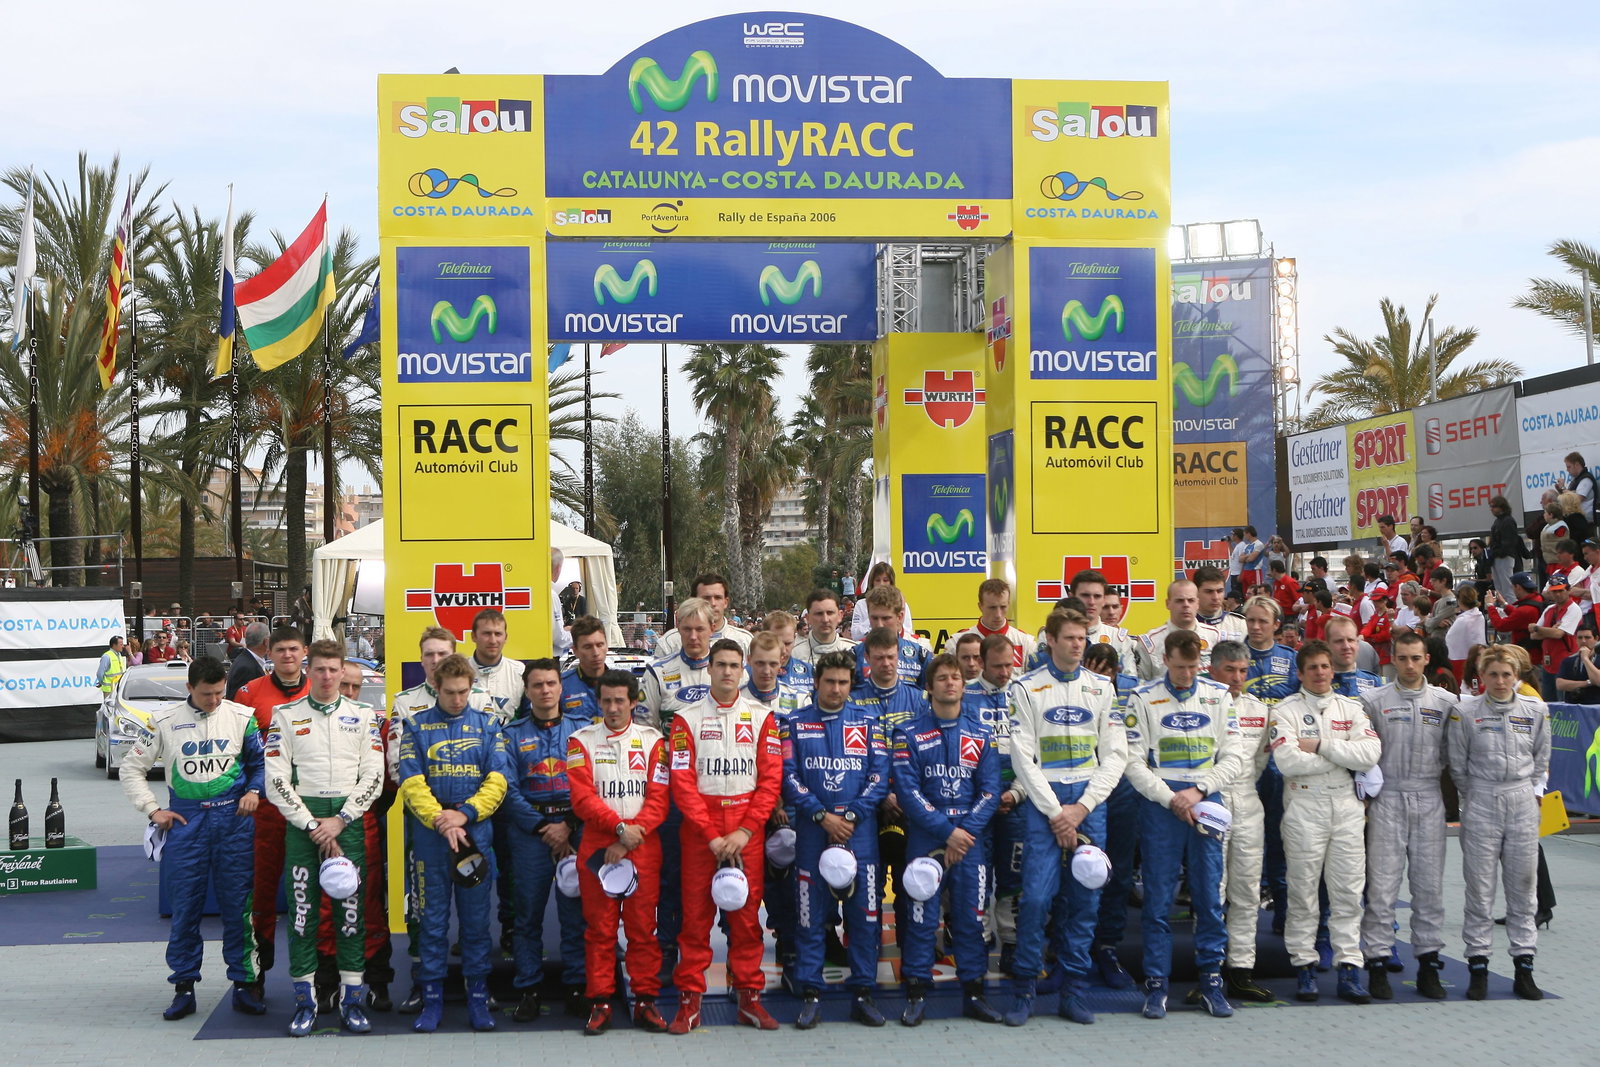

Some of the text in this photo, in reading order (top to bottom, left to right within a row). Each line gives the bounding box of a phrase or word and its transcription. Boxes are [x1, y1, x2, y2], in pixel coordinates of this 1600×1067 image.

[732, 73, 912, 104] movistar
[399, 104, 526, 138] Salou
[1031, 108, 1152, 142] Salou
[629, 119, 914, 167] 42 RallyRACC
[824, 171, 965, 190] DAURADA
[393, 205, 533, 217] COSTA DAURADA
[555, 212, 609, 226] Salou
[641, 214, 689, 222] PortAventura
[718, 212, 836, 224] Rally de España 2006
[1025, 207, 1158, 219] COSTA DAURADA
[438, 262, 492, 275] Telefónica
[1068, 262, 1120, 275] Telefónica
[564, 313, 683, 333] movistar
[730, 314, 848, 334] movistar
[398, 352, 531, 375] movistar
[1030, 350, 1157, 372] movistar
[30, 337, 38, 404] GALICIA
[324, 354, 332, 423] LA RIOJA
[1522, 405, 1600, 432] COSTA DAURAD
[413, 419, 518, 454] RACC
[664, 428, 670, 446] DE
[1044, 415, 1144, 449] RACC
[1446, 413, 1501, 443] SEAT
[1292, 438, 1342, 468] Gestetner
[1354, 423, 1407, 470] SPORT
[414, 460, 518, 473] Automóvil Club
[586, 457, 592, 475] DE
[1045, 456, 1144, 468] Automóvil Club
[1174, 451, 1238, 474] RACC
[1174, 477, 1239, 486] Automóvil Club
[1526, 472, 1556, 489] COSTA
[1449, 483, 1507, 509] SEAT
[1294, 492, 1346, 520] Gestetner
[1356, 484, 1409, 529] SPORT
[903, 551, 987, 568] movista
[0, 617, 122, 631] OSTA DAURADA
[51, 676, 101, 688] DAURA
[685, 687, 708, 700] For
[1053, 710, 1082, 722] Ford
[1170, 715, 1200, 727] Ford
[1550, 711, 1579, 739] fónica
[183, 759, 231, 775] OMV
[706, 758, 753, 776] LABARO
[805, 756, 862, 770] GAULOISES
[554, 778, 570, 790] Bu
[603, 780, 646, 799] LABARO
[0, 855, 45, 873] Freixenet
[10, 880, 16, 888] 3
